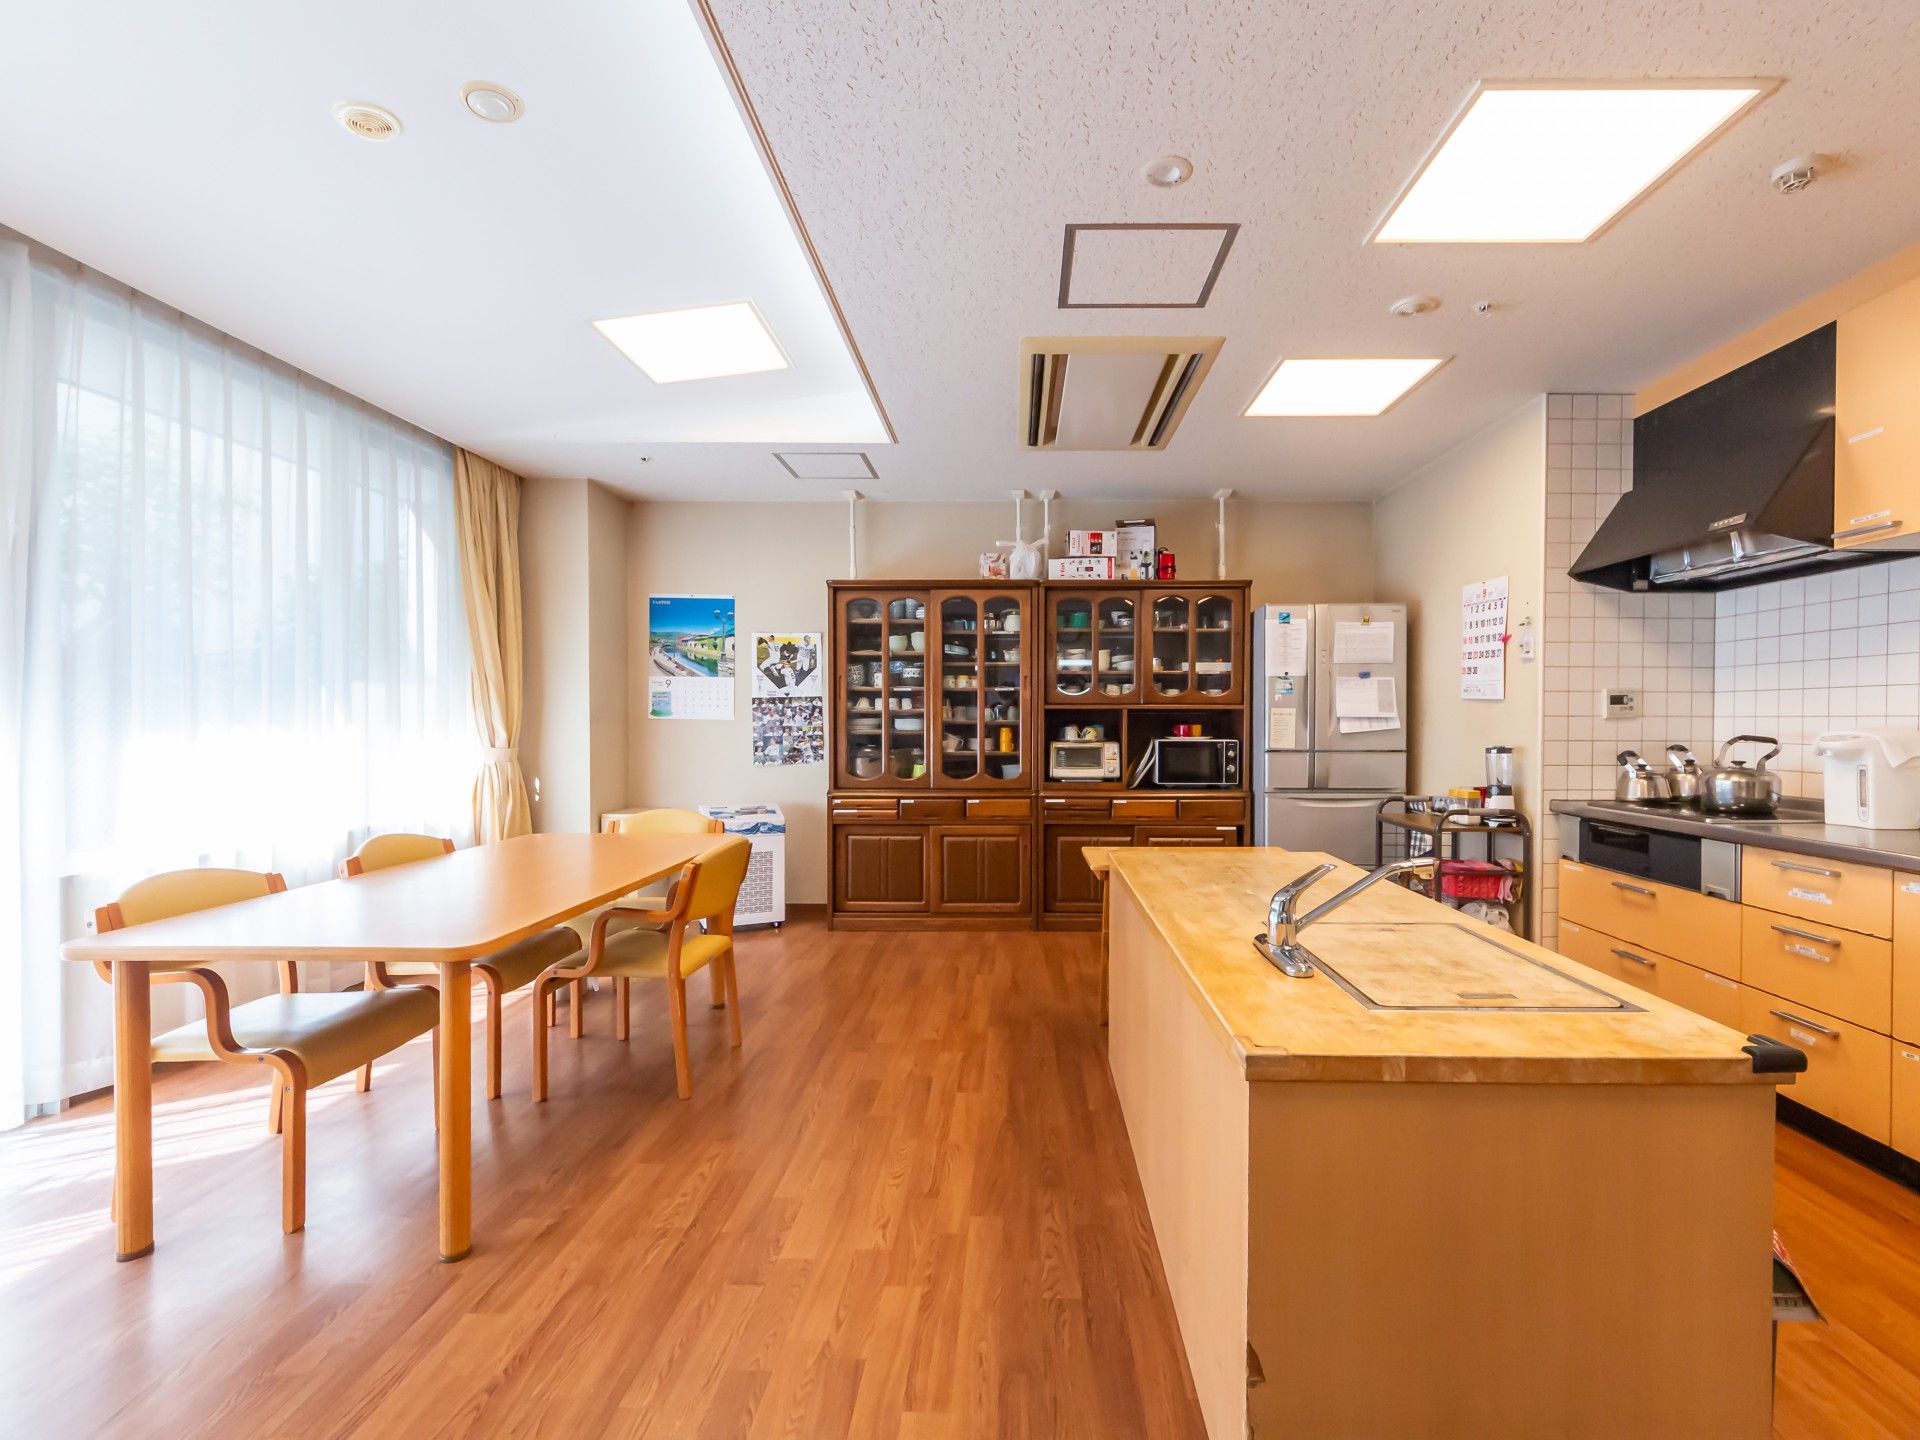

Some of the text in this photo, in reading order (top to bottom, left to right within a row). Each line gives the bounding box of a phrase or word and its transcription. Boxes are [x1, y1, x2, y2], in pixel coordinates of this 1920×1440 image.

[1482, 588, 1486, 598] 9
[1475, 604, 1479, 613] 2
[1482, 604, 1485, 612] 3
[1494, 602, 1498, 610] 5
[1500, 600, 1504, 609] 6
[1486, 618, 1491, 626] 11
[1492, 618, 1497, 626] 12
[1499, 616, 1504, 625] 13
[1468, 636, 1473, 644] 15
[1474, 636, 1479, 644] 16
[1480, 634, 1484, 643] 17
[1486, 634, 1490, 642] 18
[1492, 634, 1496, 642] 19
[1467, 652, 1472, 660] 22
[1473, 651, 1478, 660] 23
[1479, 650, 1484, 658] 24
[1484, 650, 1490, 658] 25
[1490, 650, 1496, 658] 26
[1496, 648, 1501, 658] 27
[1467, 666, 1472, 675] 29
[1472, 666, 1478, 674] 30
[665, 680, 672, 688] 9
